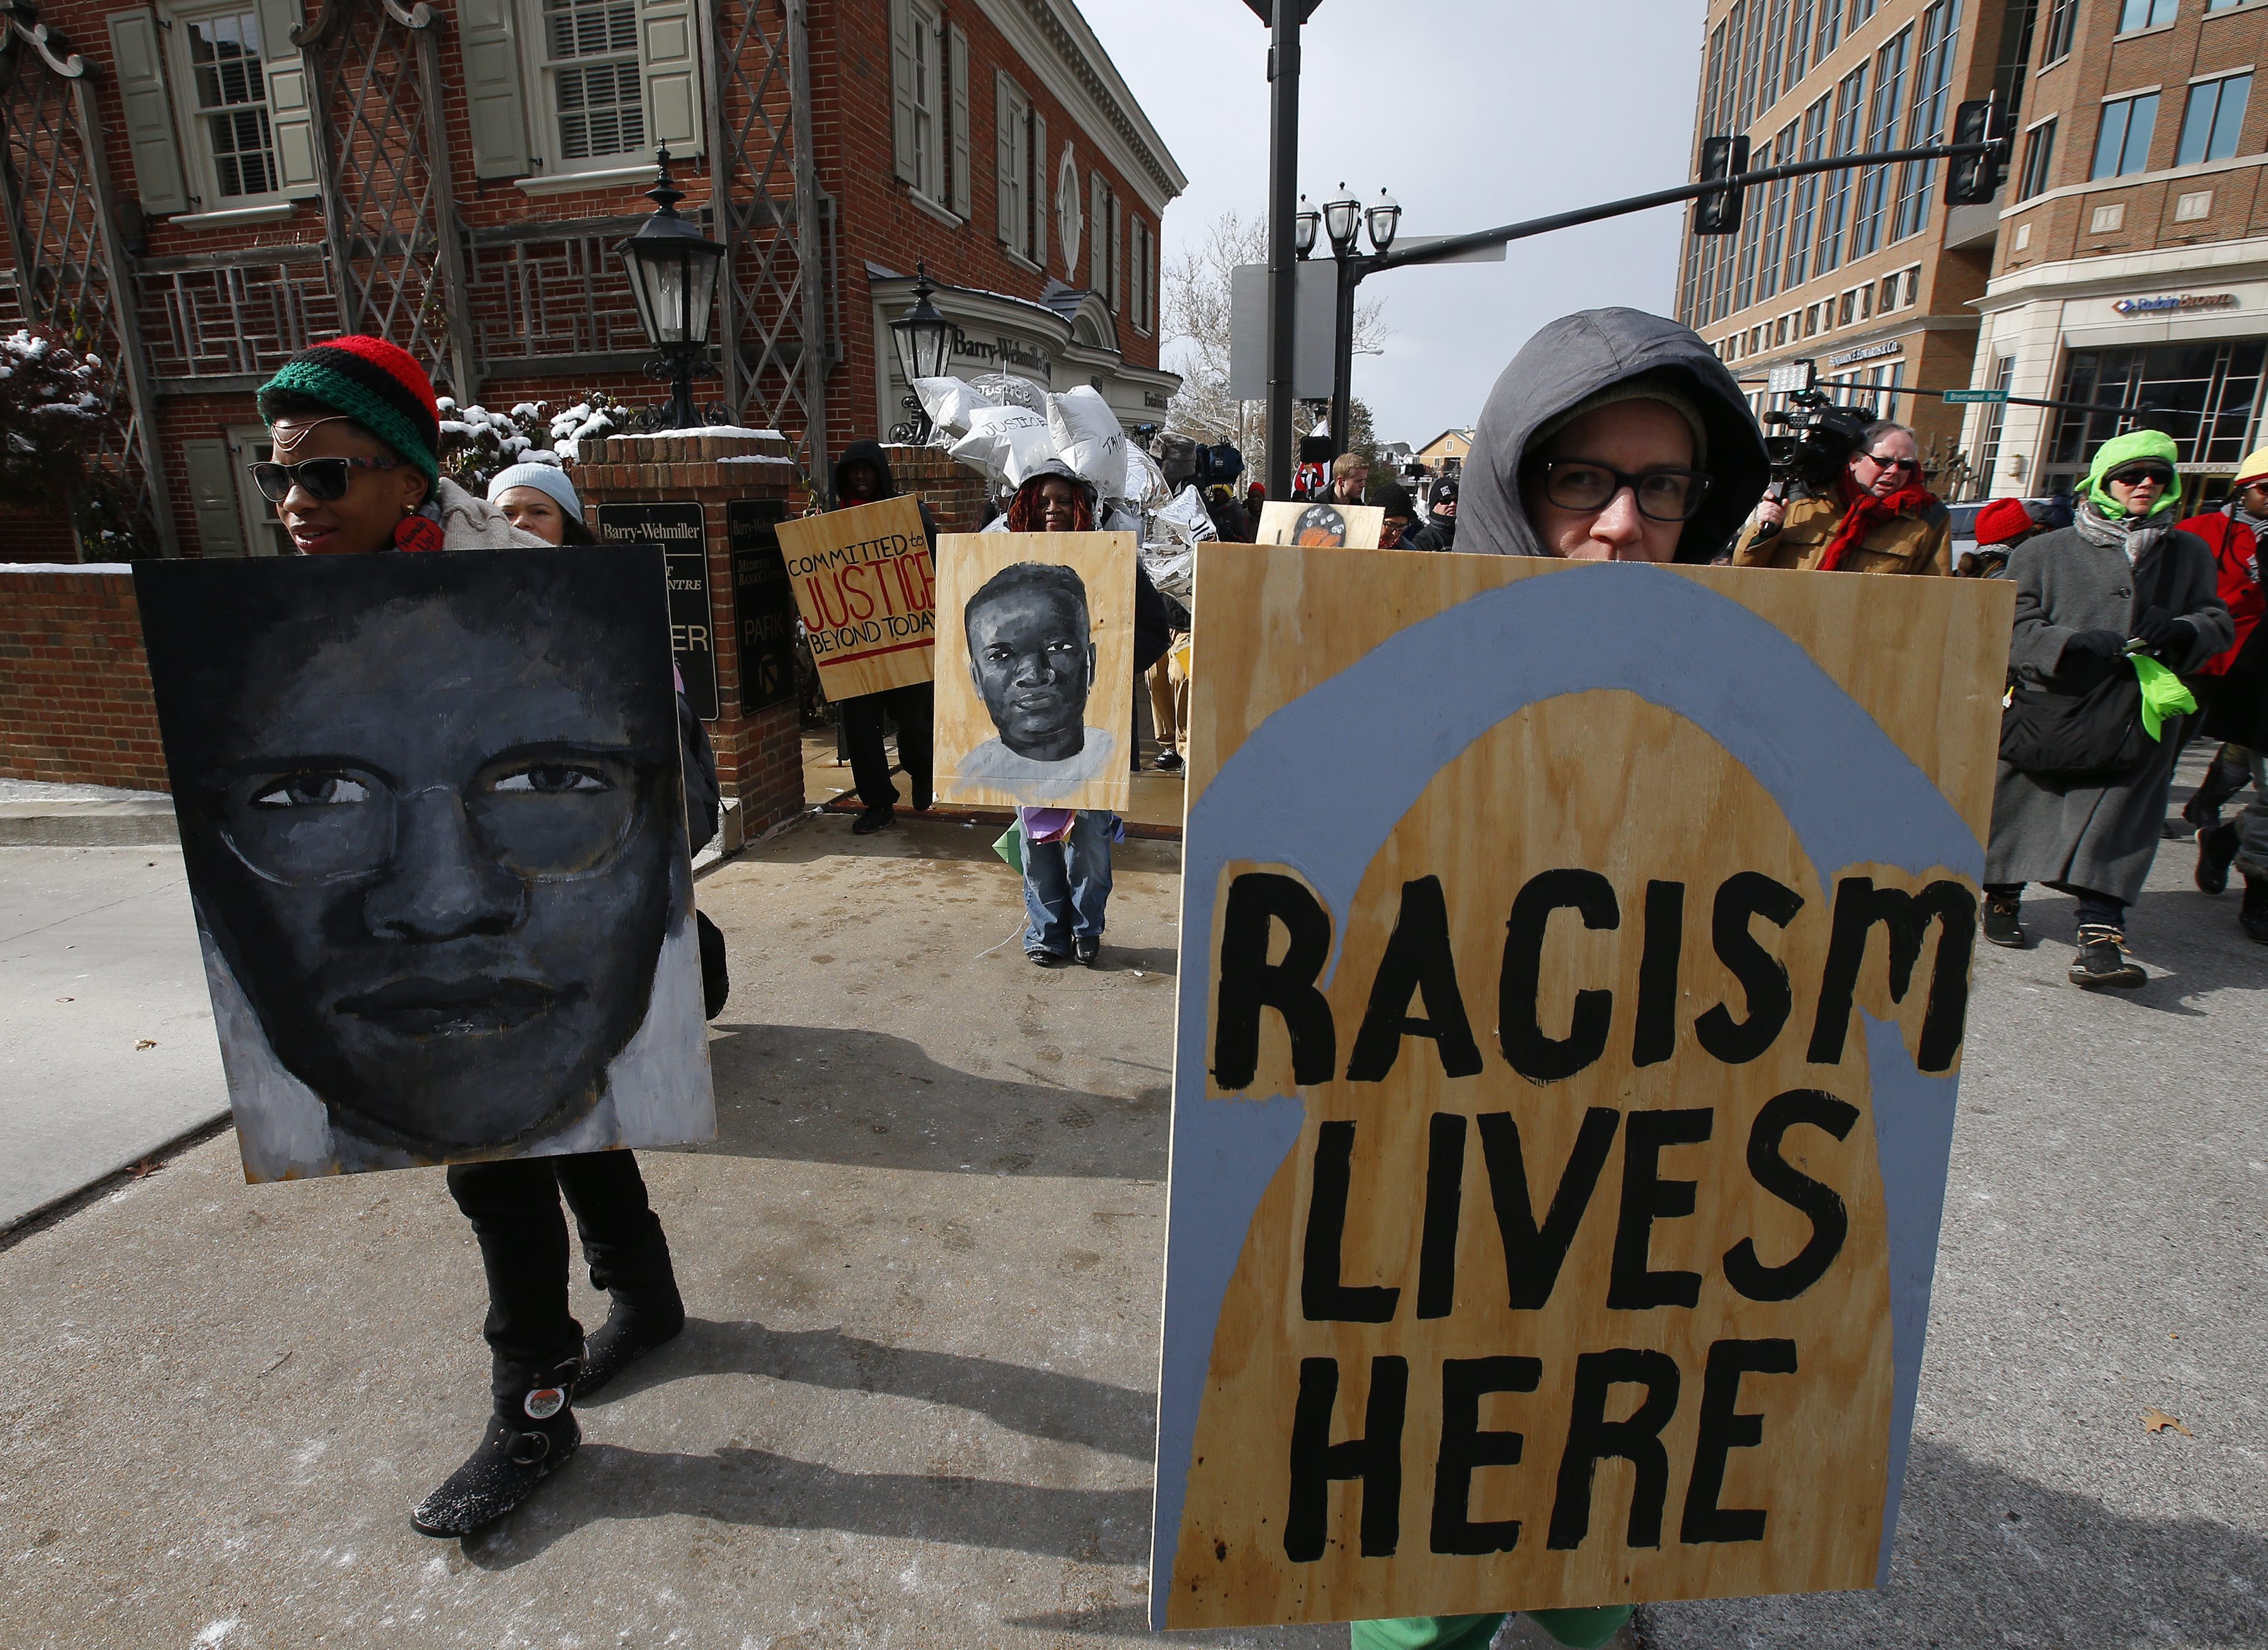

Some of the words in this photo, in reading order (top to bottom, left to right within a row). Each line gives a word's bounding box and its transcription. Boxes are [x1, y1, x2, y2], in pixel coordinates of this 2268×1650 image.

[2135, 294, 2235, 310] RubinBrown
[1950, 392, 1984, 401] Brentwood
[1987, 392, 2003, 401] Blvd
[982, 416, 1048, 437] JUSTICE
[399, 520, 427, 548] Hands
[415, 529, 437, 550] Up!
[603, 522, 700, 543] Barry-Wehmiller
[788, 534, 908, 577] COMMITTED
[909, 530, 925, 547] to
[803, 550, 936, 632] JUSTICE
[744, 612, 785, 646] PARK
[809, 621, 881, 655] BEYOND
[1210, 868, 1978, 1090] RACISM
[1300, 1087, 1860, 1324] LIVES
[1283, 1338, 1798, 1563] HERE
